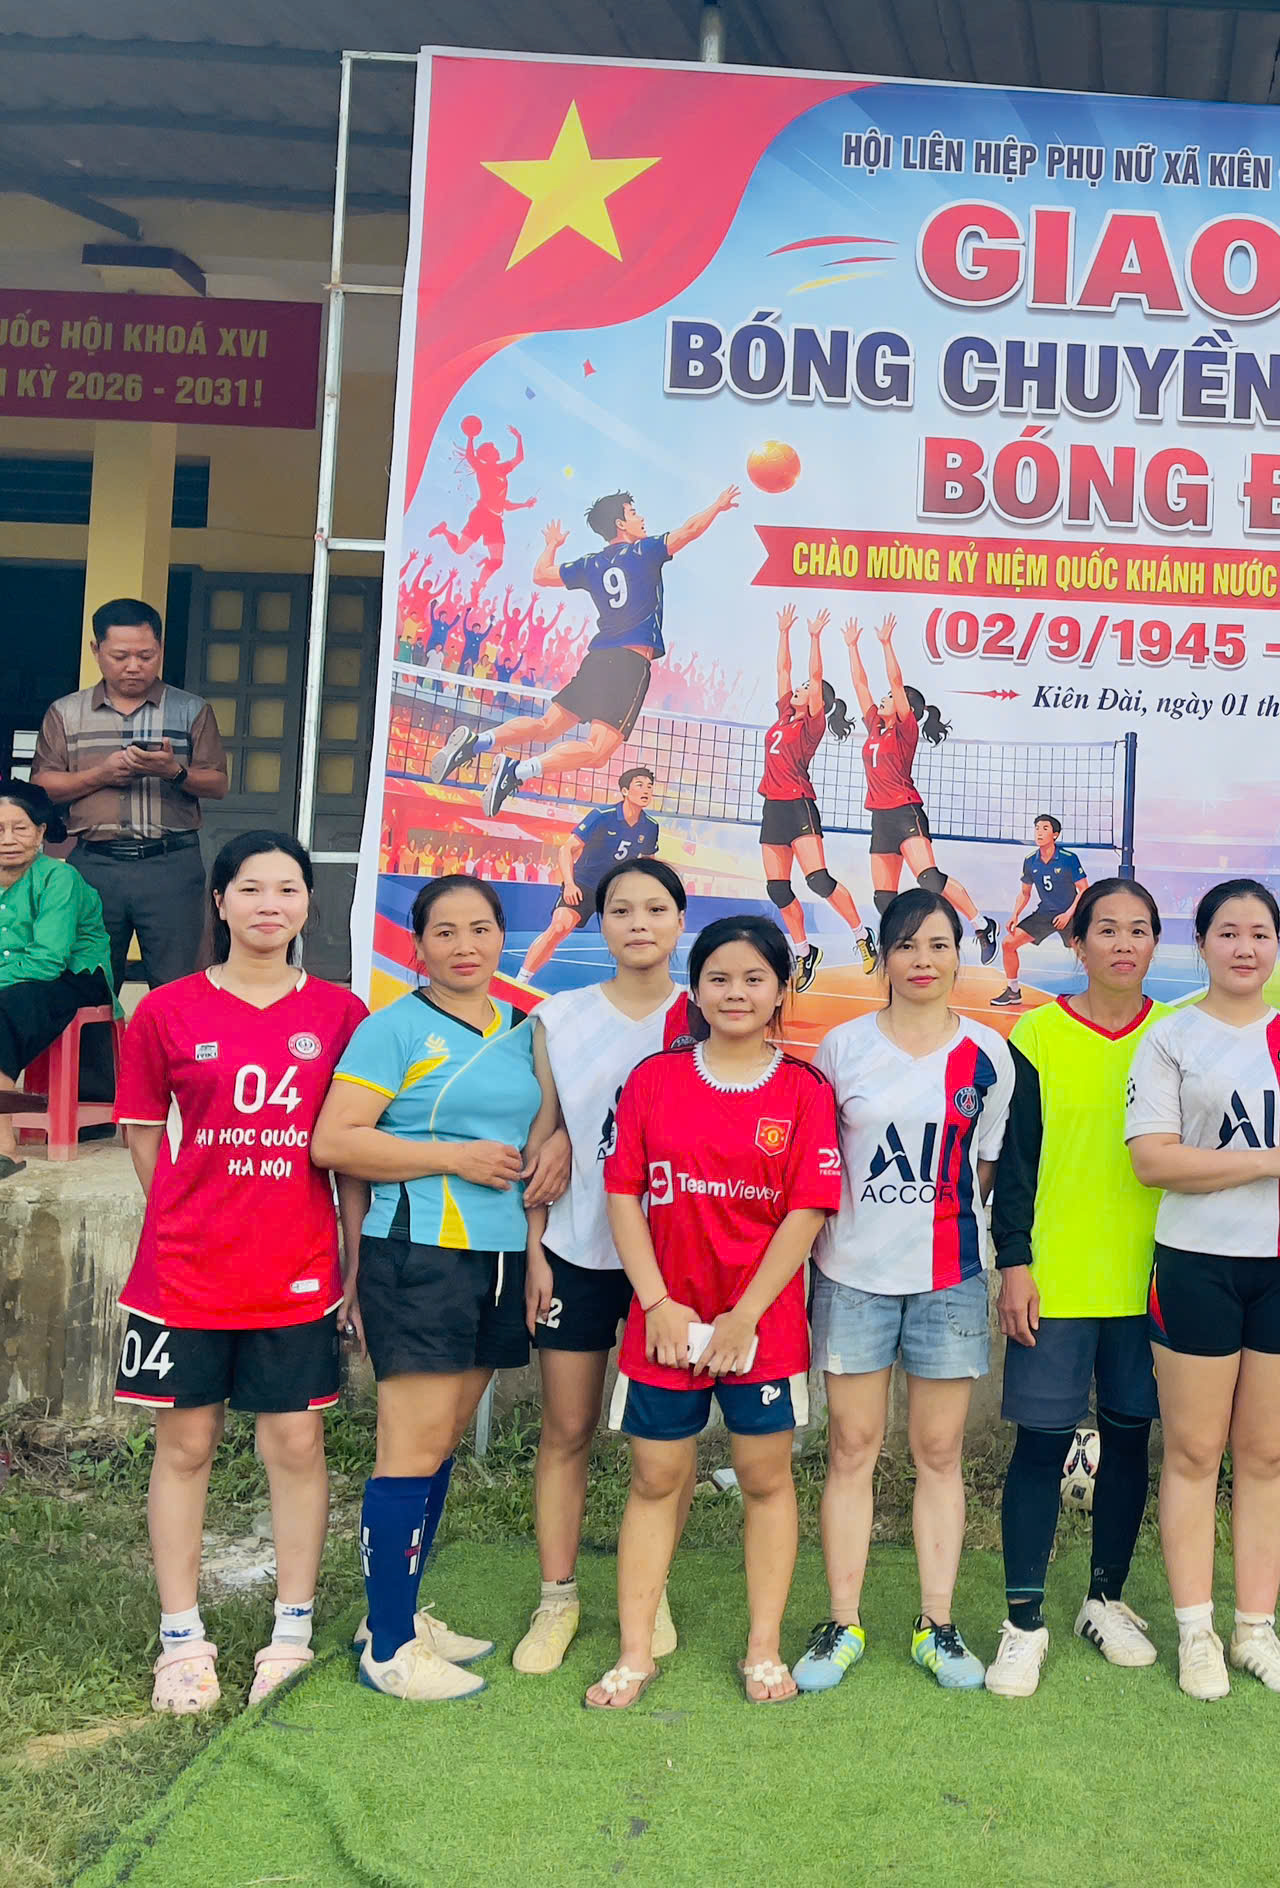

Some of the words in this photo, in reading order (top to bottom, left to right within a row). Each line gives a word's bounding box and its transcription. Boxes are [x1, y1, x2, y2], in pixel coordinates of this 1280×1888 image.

[843, 128, 893, 175] HỘI
[903, 132, 964, 175] LIÊN
[974, 136, 1036, 183] HIỆP
[1047, 144, 1103, 187] PHỤ
[1114, 144, 1156, 184] NỮ
[1163, 146, 1200, 187] XÃ
[1208, 149, 1271, 189] KIÊN
[61, 316, 112, 355] HỘI
[123, 321, 207, 355] KHOÁ
[217, 328, 268, 358] XVI
[667, 311, 913, 406] BÓNG
[17, 363, 57, 398] KỲ
[66, 371, 144, 401] 2026
[175, 376, 263, 408] 2031!
[919, 425, 1213, 531] BÓNG
[603, 567, 628, 609] 9
[792, 537, 859, 577] CHÀO
[867, 541, 939, 582] MỪNG
[948, 541, 979, 583] KỶ
[986, 547, 1048, 592] NIỆM
[1056, 547, 1118, 592] QUỐC
[1126, 554, 1205, 594] KHÁNH
[1212, 557, 1277, 598] NƯỚC
[923, 607, 1247, 668] (02/9/1945
[1032, 685, 1090, 710] Kiên
[1097, 688, 1147, 716] Đài,
[1156, 692, 1213, 721] ngày
[1221, 693, 1249, 717] 01
[769, 730, 783, 755] 2
[869, 743, 880, 768] 7
[614, 840, 632, 861] 5
[1043, 875, 1053, 891] 5
[233, 1064, 303, 1115] 04
[218, 1128, 256, 1148] HỌC
[228, 1156, 254, 1176] HÀ
[260, 1156, 292, 1181] NỘI
[860, 1185, 954, 1204] ACCOR
[121, 1329, 175, 1380] 04
